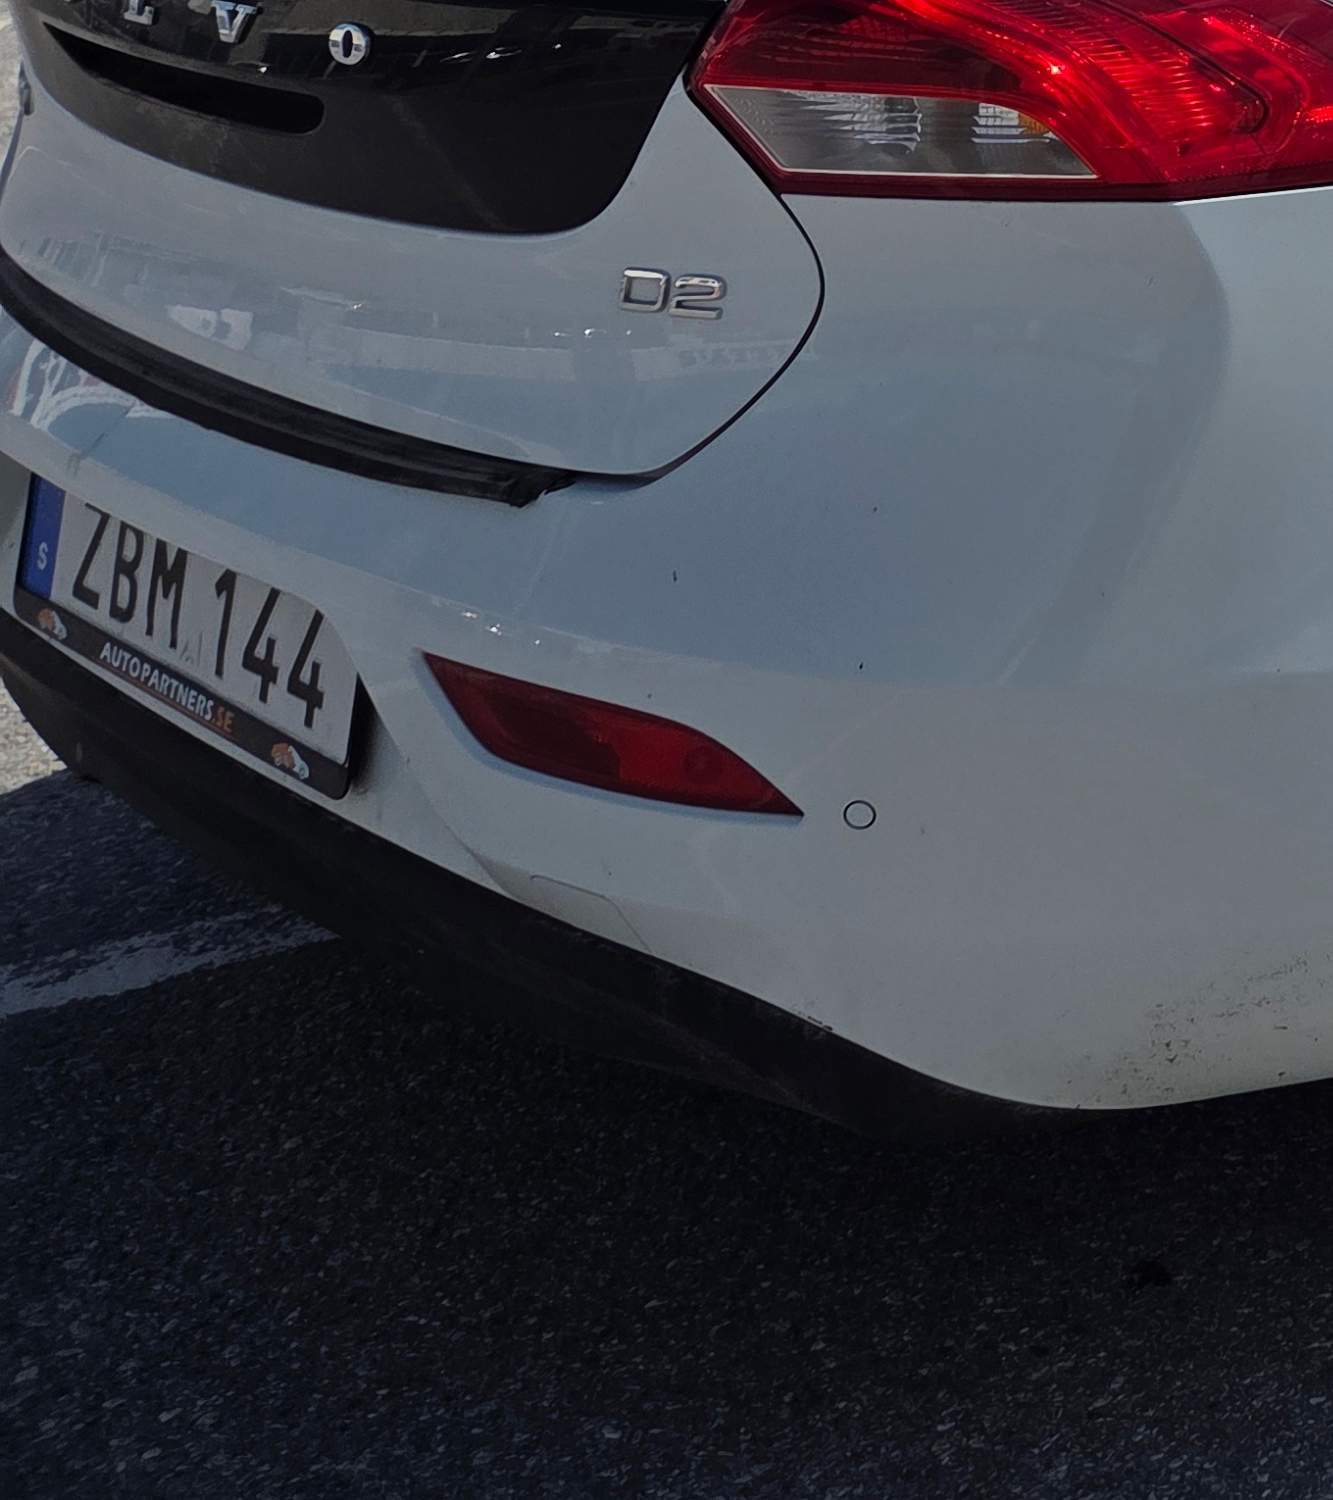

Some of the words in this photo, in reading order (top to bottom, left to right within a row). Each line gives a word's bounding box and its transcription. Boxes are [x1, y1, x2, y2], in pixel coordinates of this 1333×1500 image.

[619, 266, 727, 319] D2
[37, 541, 49, 571] S
[72, 501, 189, 650] ZBM
[214, 568, 325, 729] 144
[99, 641, 236, 734] AUTOPARTNERS.SE
